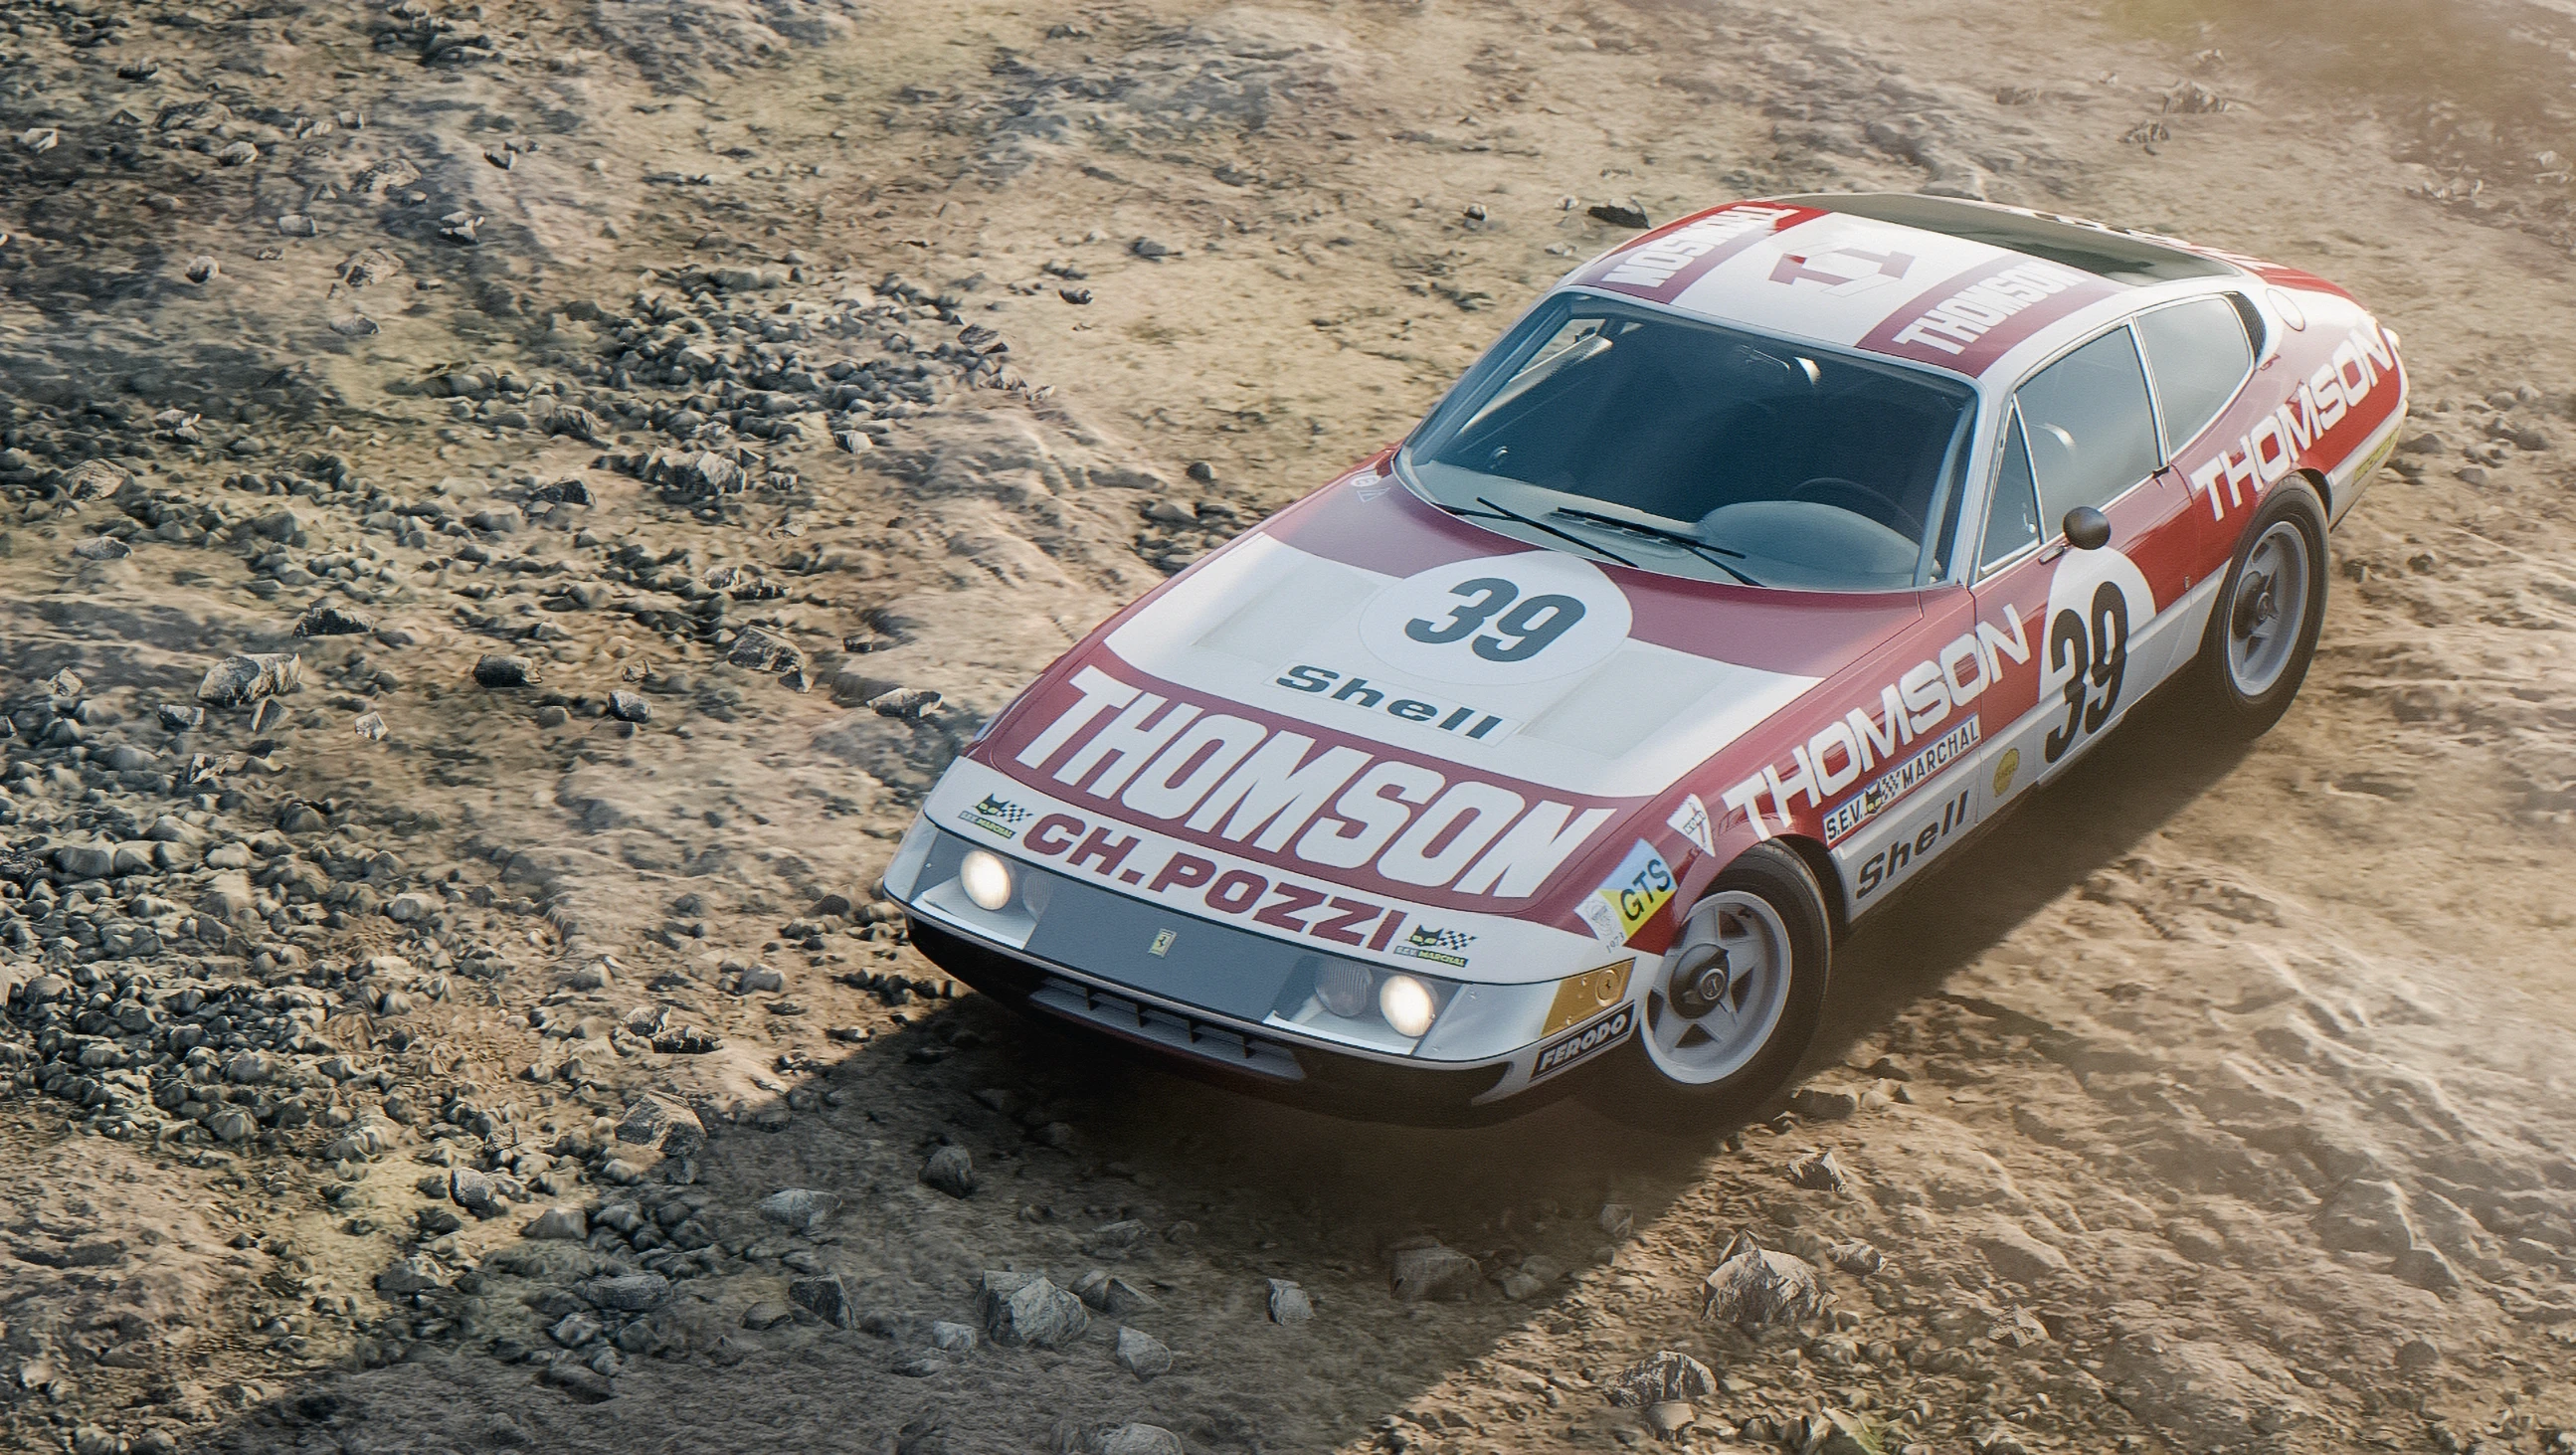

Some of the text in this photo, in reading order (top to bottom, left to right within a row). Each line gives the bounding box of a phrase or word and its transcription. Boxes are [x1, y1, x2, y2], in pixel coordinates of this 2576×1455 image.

[1892, 261, 2088, 356] THOMSON
[2190, 313, 2394, 522] THOMSON
[1403, 577, 1586, 662] 39
[2044, 581, 2128, 764] 39
[1276, 663, 1504, 741] Shell
[1722, 603, 2031, 842] THOMSON
[1014, 664, 1617, 898] THOMSON
[1826, 721, 1979, 840] S.E.V. MARCHAL
[1022, 813, 1408, 953] CH.POZZI
[1619, 858, 1673, 922] GTS
[1856, 790, 1969, 900] Shell
[1539, 1013, 1627, 1072] FERODO
